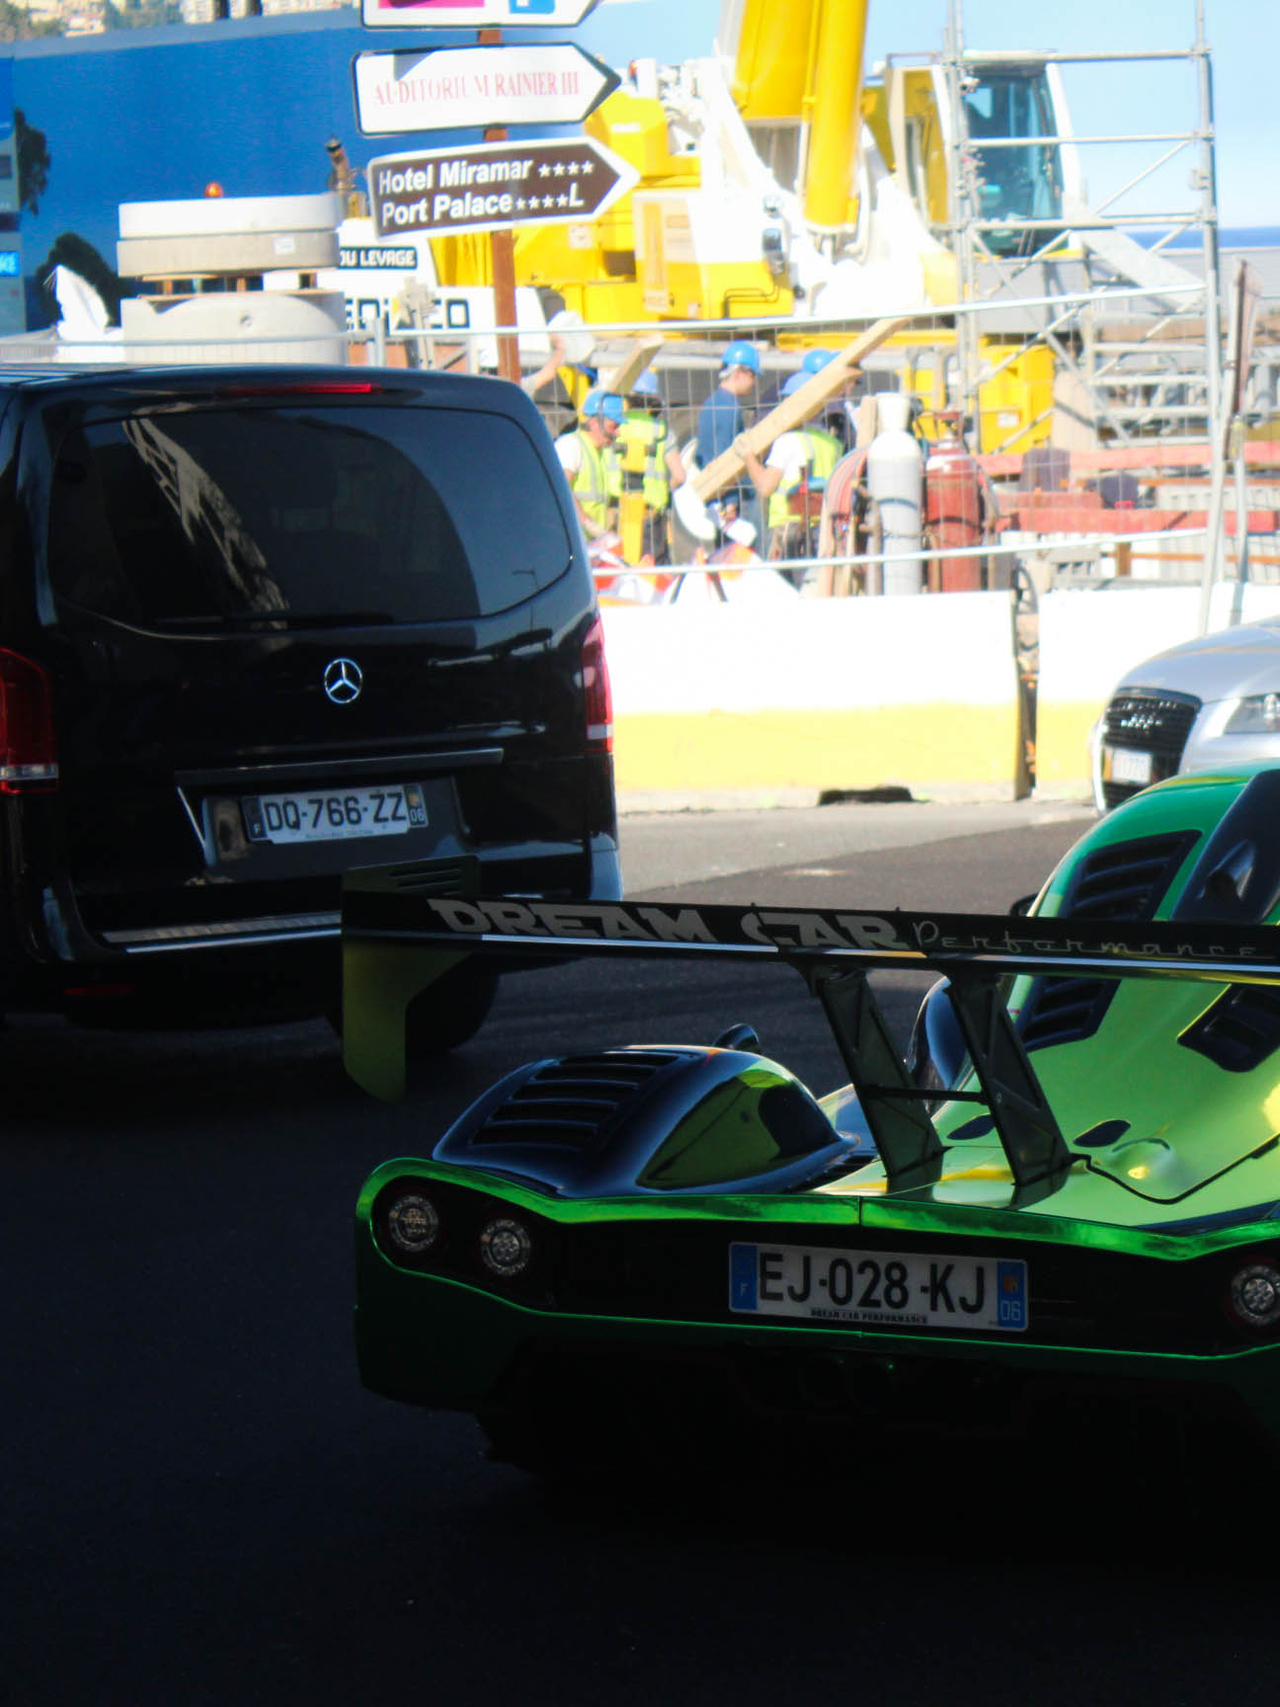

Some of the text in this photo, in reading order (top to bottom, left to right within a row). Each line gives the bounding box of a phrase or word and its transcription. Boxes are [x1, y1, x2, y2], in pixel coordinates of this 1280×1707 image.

[374, 72, 580, 106] AUDITORIUM RAINIER III
[379, 159, 533, 195] Hotel Miramar
[383, 182, 584, 227] Port Palace L
[360, 250, 415, 267] LEVAGE
[264, 792, 407, 831] DQ-766-ZZ
[410, 808, 426, 823] 06
[426, 899, 1273, 959] DREAM CAR Performance
[758, 1252, 985, 1314] EJ-028-KJ
[1000, 1300, 1022, 1321] 06
